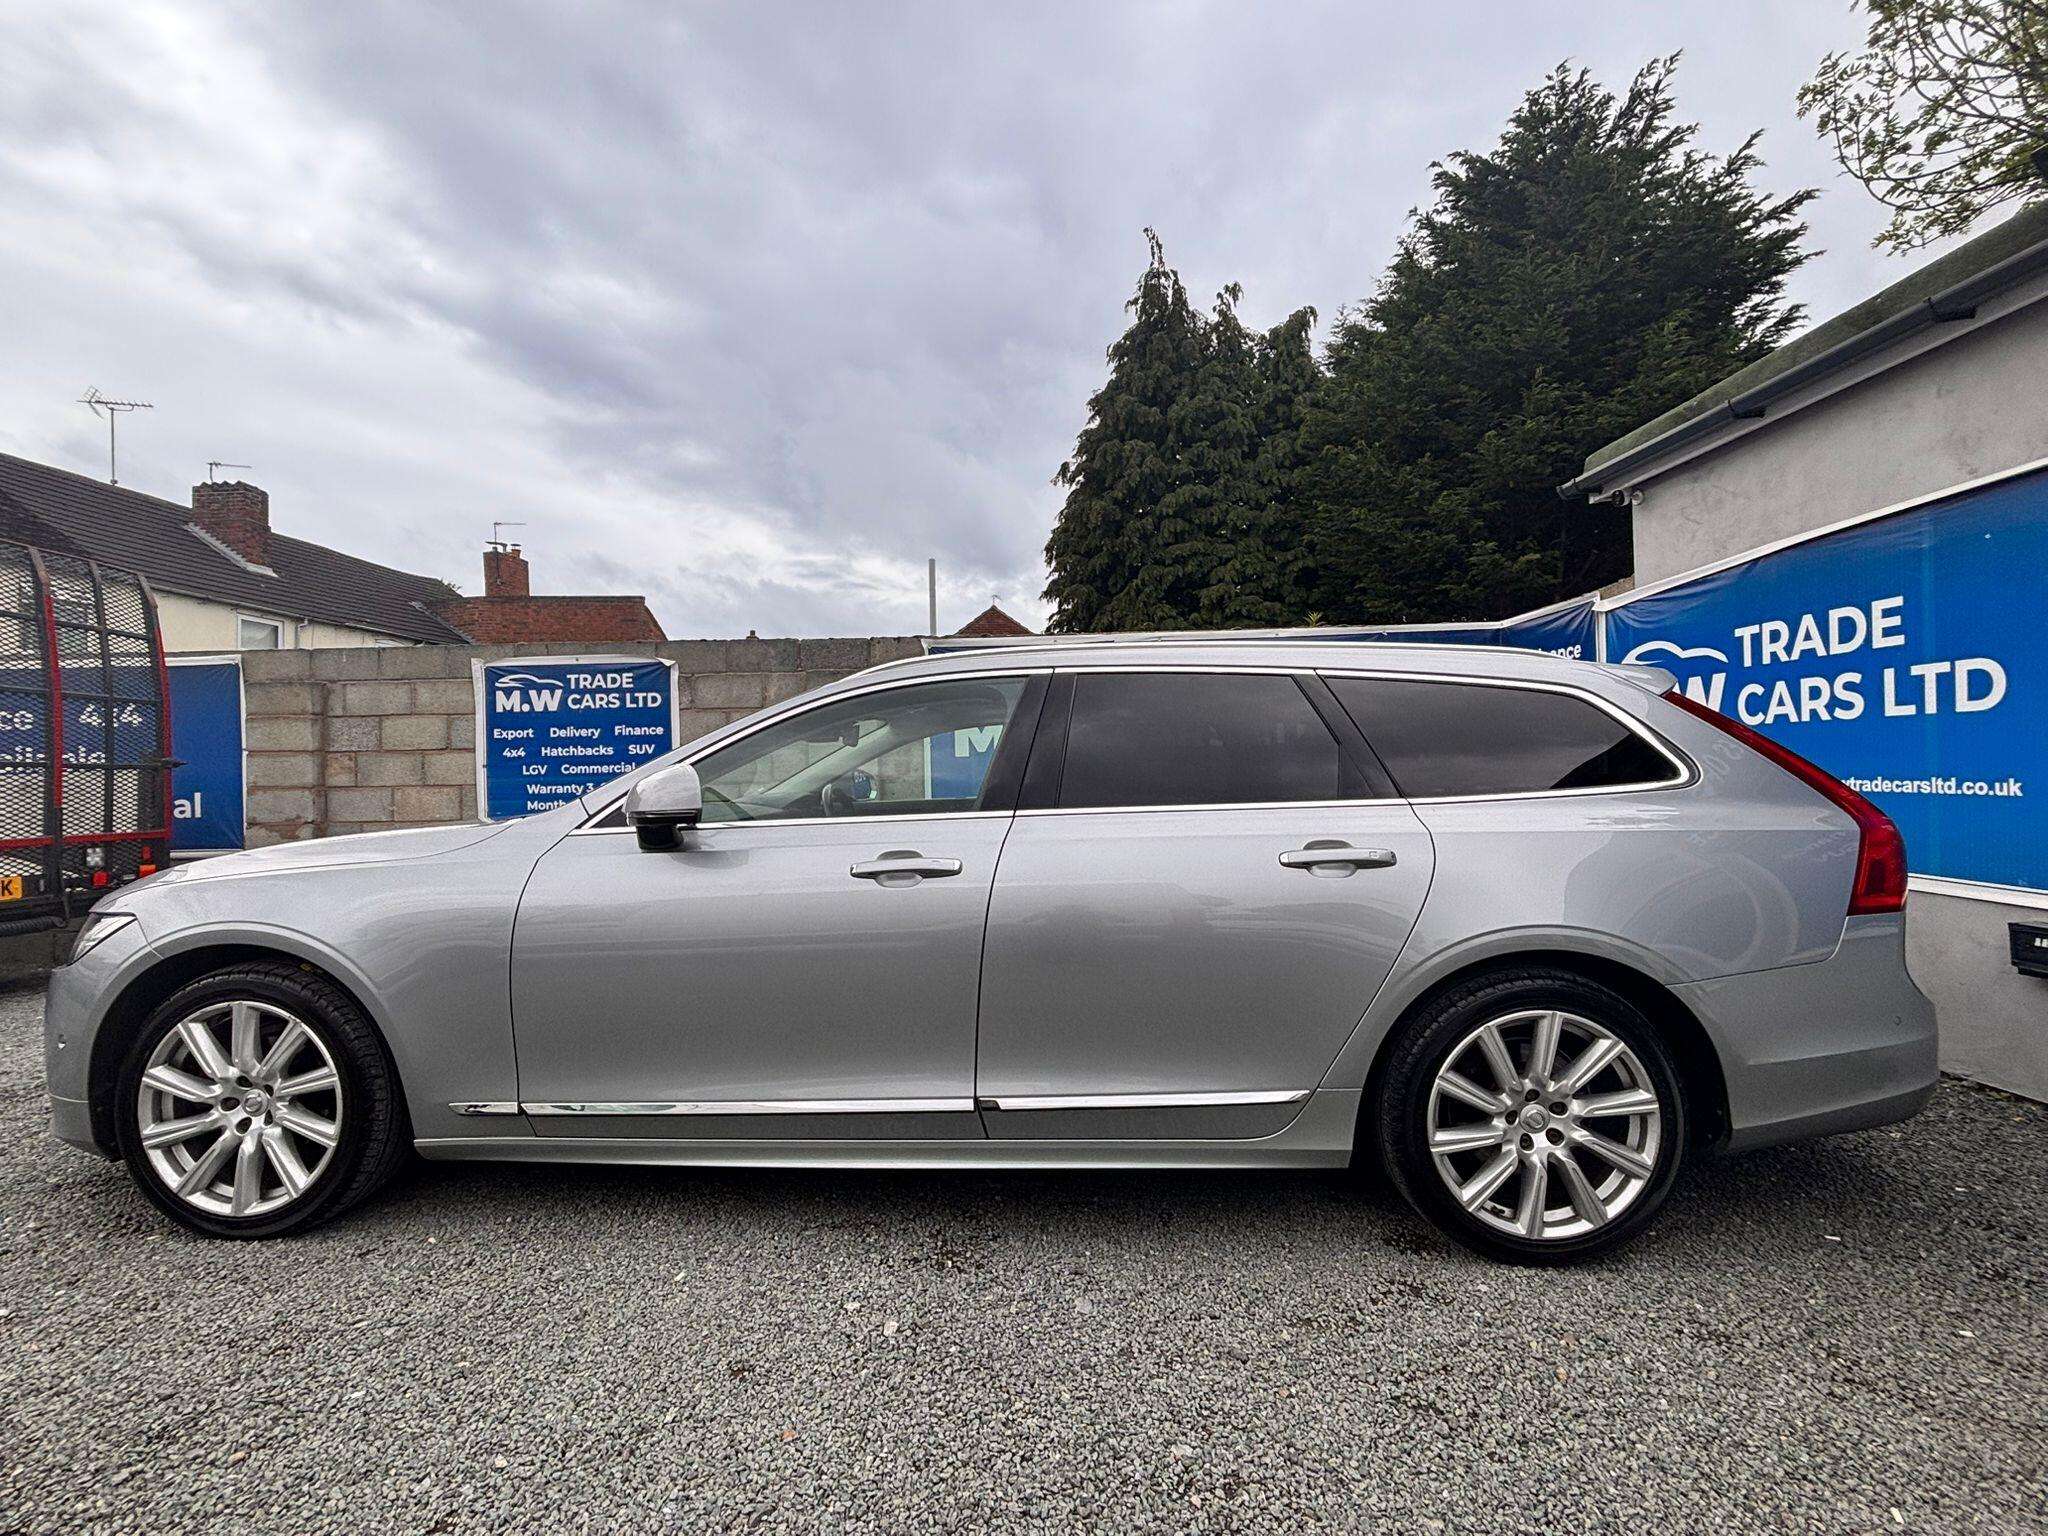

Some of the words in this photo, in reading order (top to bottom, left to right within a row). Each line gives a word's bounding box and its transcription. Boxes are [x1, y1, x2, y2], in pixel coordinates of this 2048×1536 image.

[1734, 595, 1906, 668] TRADE
[566, 672, 634, 690] TRADE
[1737, 672, 1865, 726] CARS
[1883, 657, 2008, 717] LTD
[495, 689, 563, 713] M.W
[567, 693, 621, 710] CARS
[625, 692, 662, 709] LTD
[493, 727, 535, 740] Export
[550, 726, 600, 739] Delivery
[614, 725, 664, 737] Finance
[502, 747, 526, 758] 4x4
[541, 744, 614, 757] Hatchbacks
[628, 744, 655, 755] SUV
[522, 764, 548, 776] LGV
[526, 783, 584, 796] Warranty
